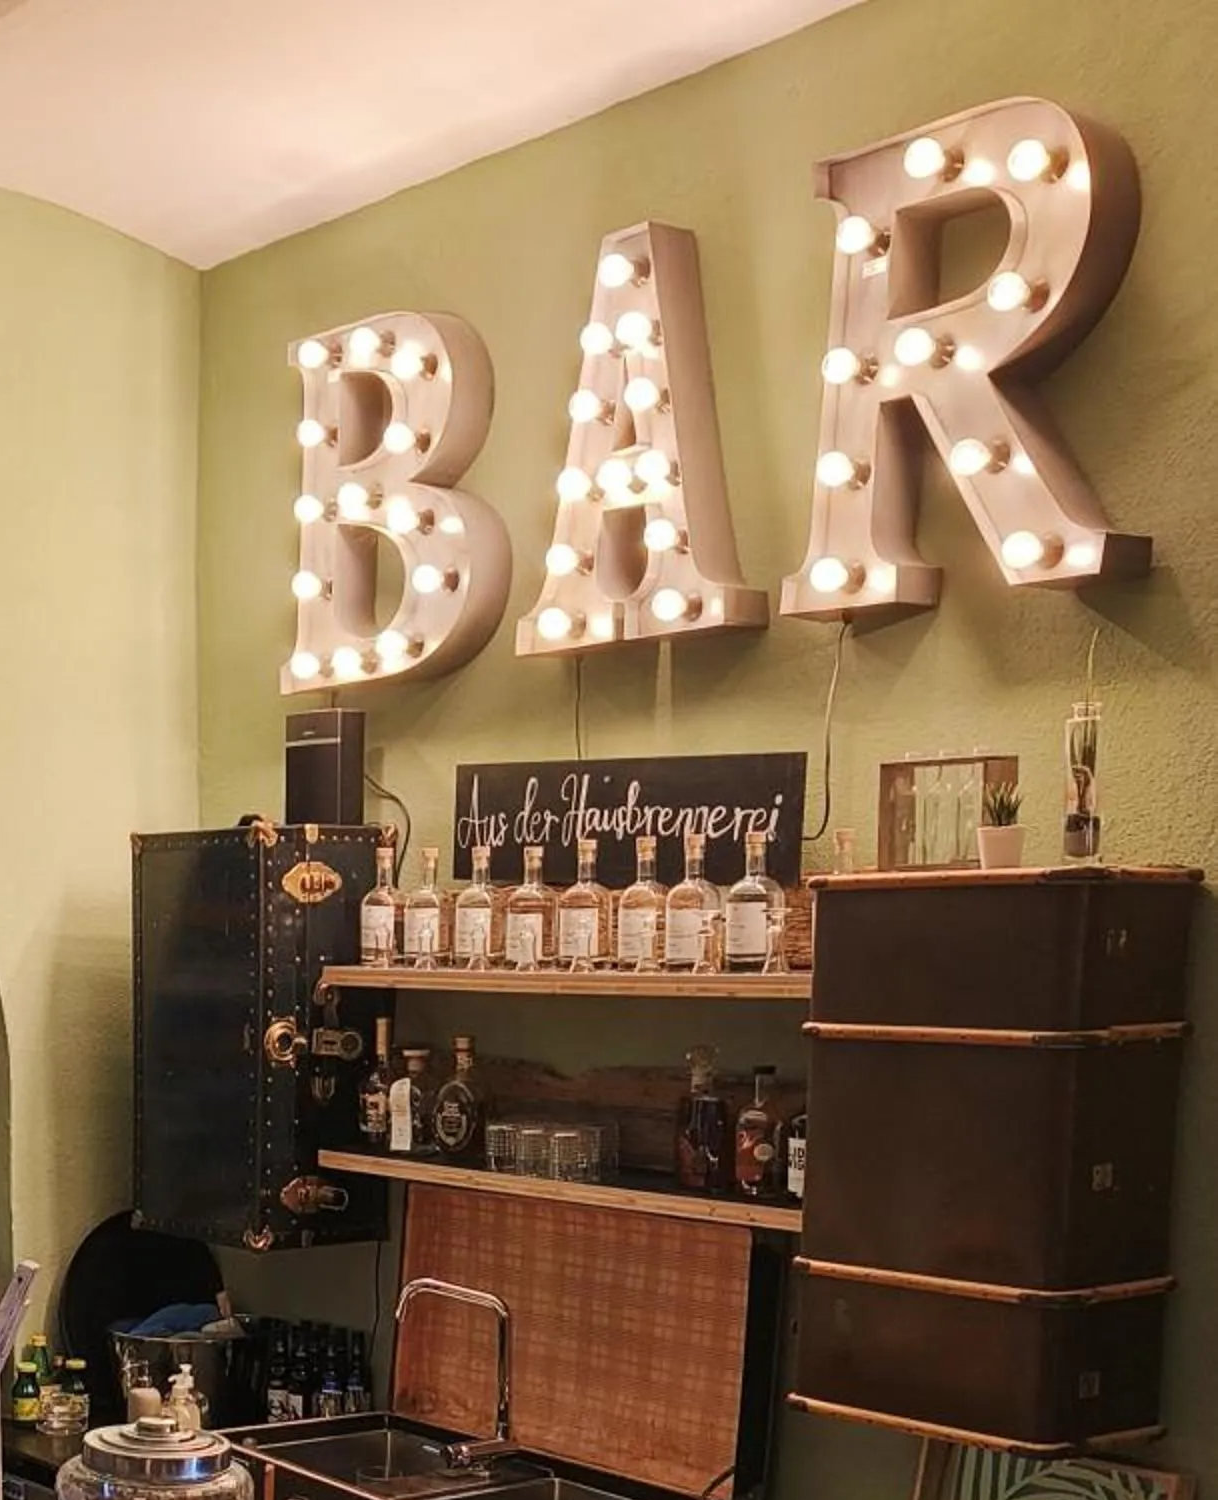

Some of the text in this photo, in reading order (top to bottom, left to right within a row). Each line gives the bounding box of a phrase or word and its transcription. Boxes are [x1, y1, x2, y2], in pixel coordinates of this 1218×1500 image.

[280, 96, 1153, 695] BAR
[458, 773, 508, 848] Aus
[513, 775, 560, 845] der
